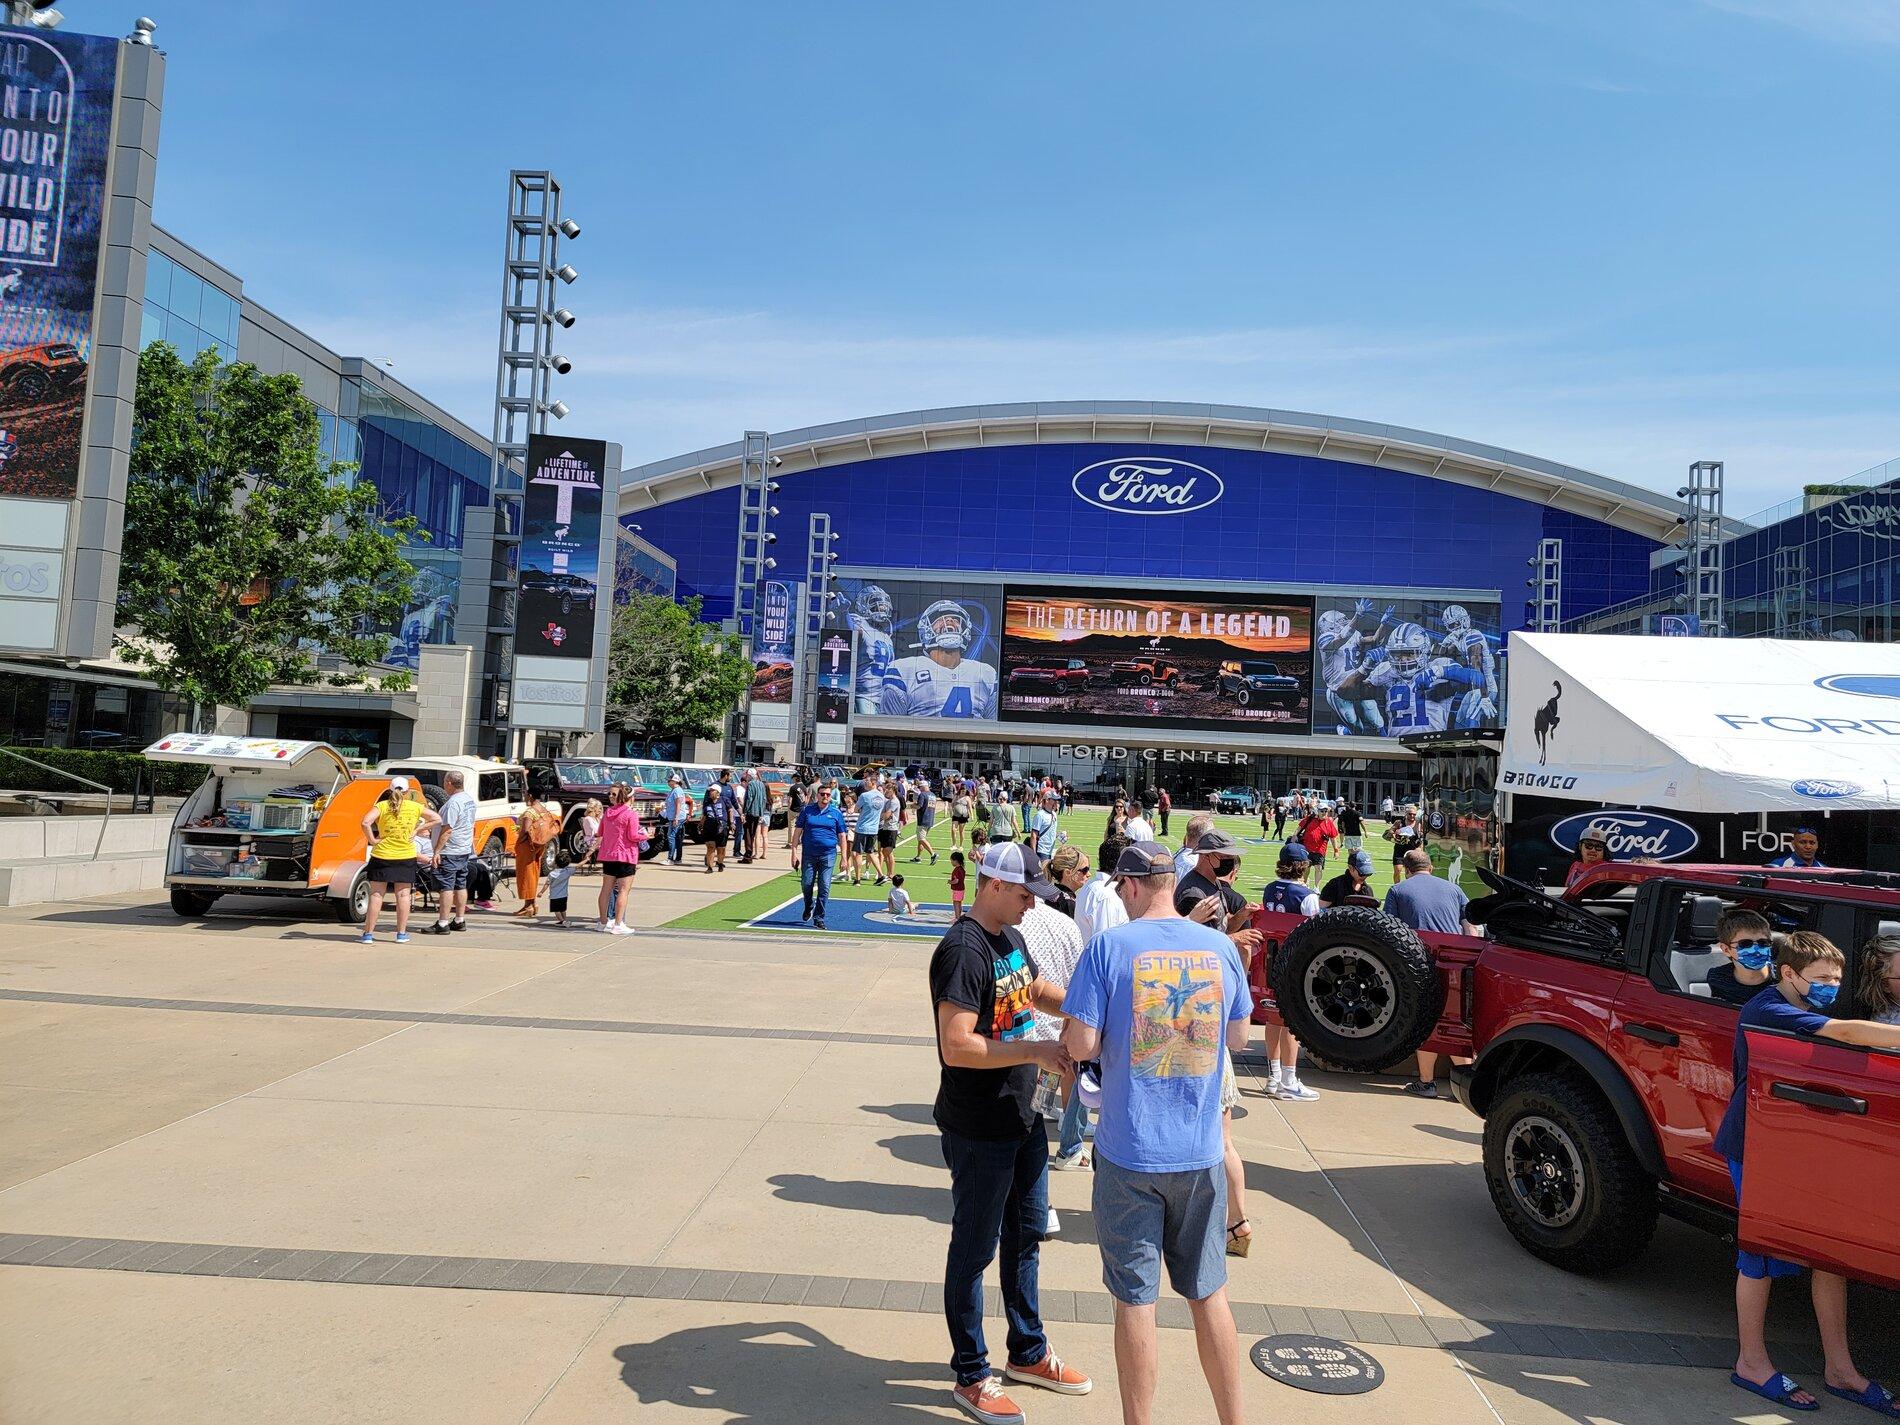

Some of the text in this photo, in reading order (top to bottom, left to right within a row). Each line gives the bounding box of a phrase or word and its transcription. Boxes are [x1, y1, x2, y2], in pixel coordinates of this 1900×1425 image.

[1, 43, 28, 76] AP
[3, 85, 62, 124] NTO
[0, 128, 57, 167] OUR
[0, 218, 48, 257] IDE
[550, 457, 582, 469] LIFETIME
[536, 466, 596, 482] ADVENTURE
[1099, 464, 1197, 505] Ford
[768, 585, 778, 594] TAP
[767, 596, 786, 606] INTO
[767, 607, 786, 617] YOUR
[1026, 606, 1291, 638] THE RETURN OF A LEGEND
[766, 619, 785, 629] WILD
[765, 630, 784, 641] SIDE
[1025, 696, 1050, 704] BRONCO
[1389, 684, 1430, 727] 21
[1059, 744, 1249, 765] FORD CENTER
[1503, 771, 1578, 790] BRONCO
[1742, 831, 1795, 852] FOR
